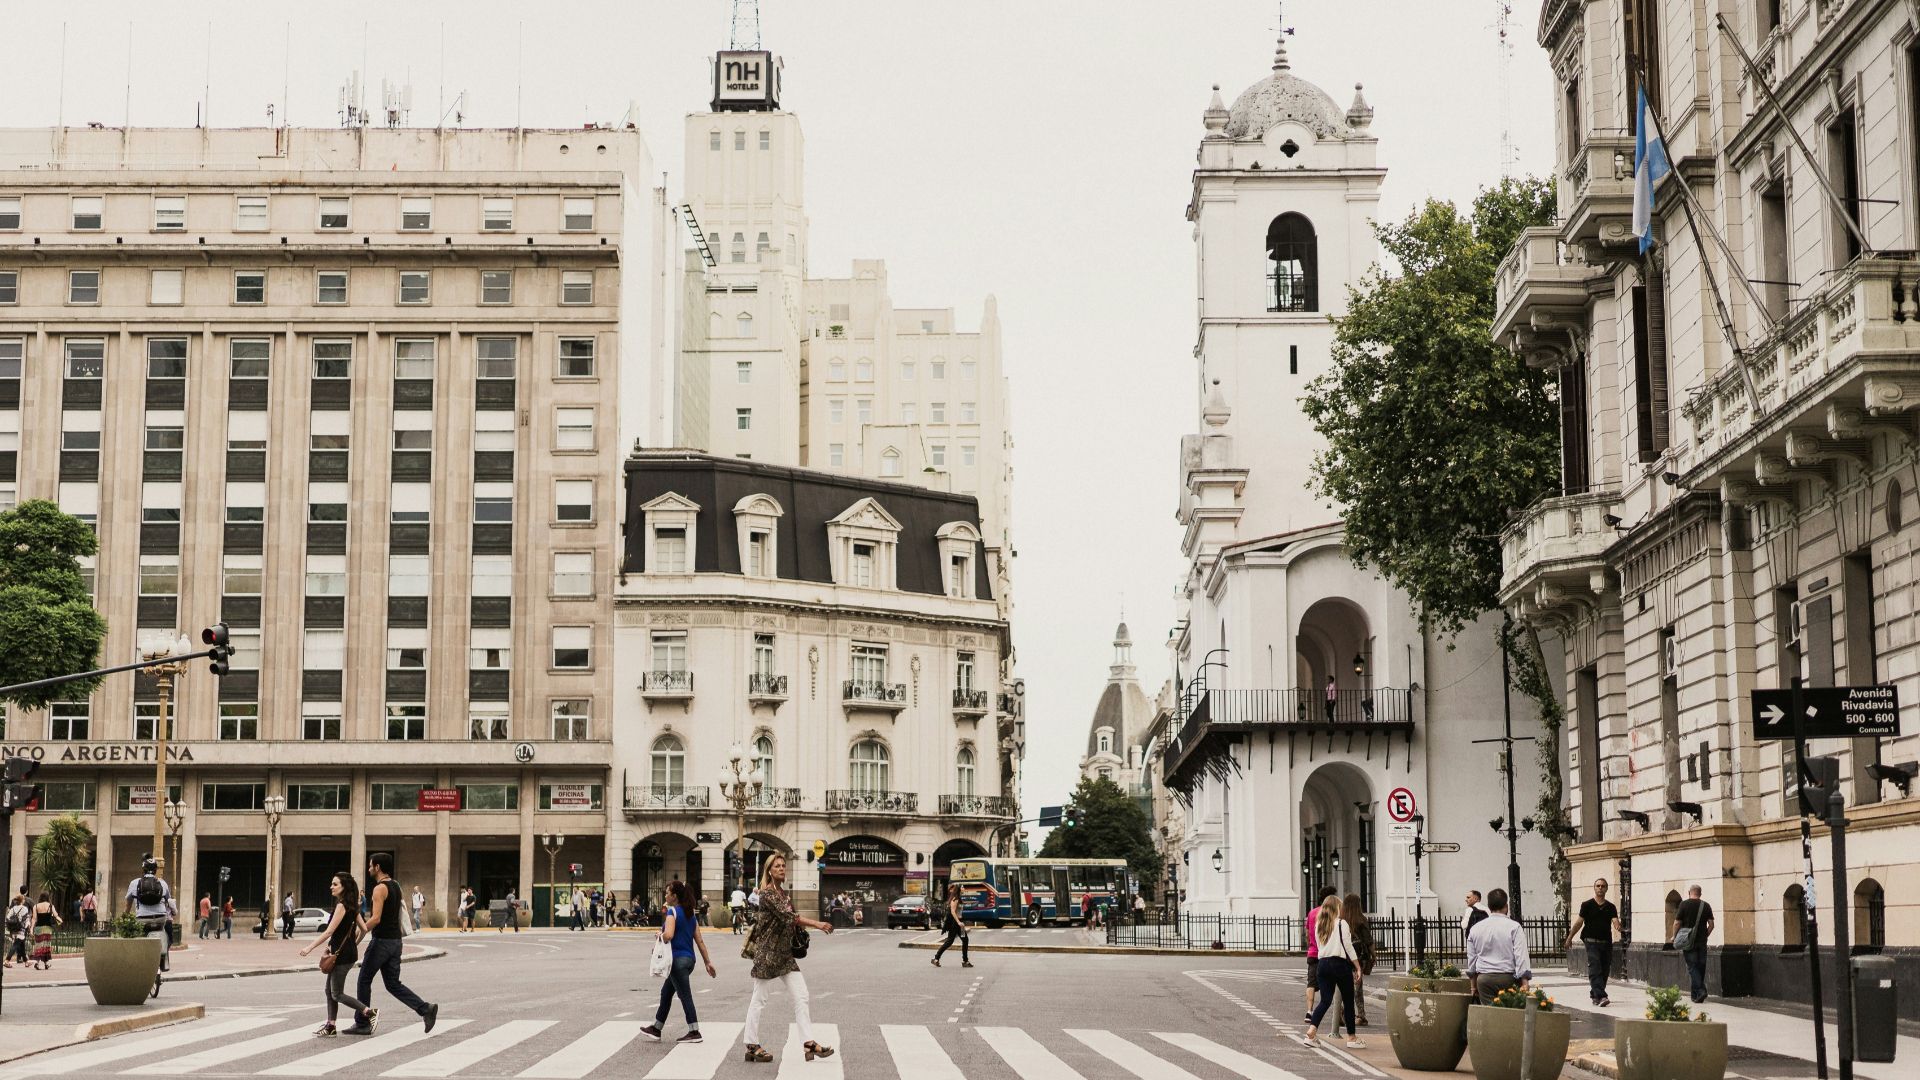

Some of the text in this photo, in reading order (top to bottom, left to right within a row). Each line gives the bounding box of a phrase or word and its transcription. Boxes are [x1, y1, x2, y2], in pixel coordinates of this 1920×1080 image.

[1849, 688, 1893, 699] Avenida
[1841, 699, 1894, 711] Rivadavia
[1014, 681, 1024, 757] CITY
[1846, 713, 1866, 724] 500
[1875, 712, 1895, 723] 600
[61, 746, 194, 761] ARGENTINA
[1396, 795, 1408, 814] E
[839, 851, 856, 862] GRAN
